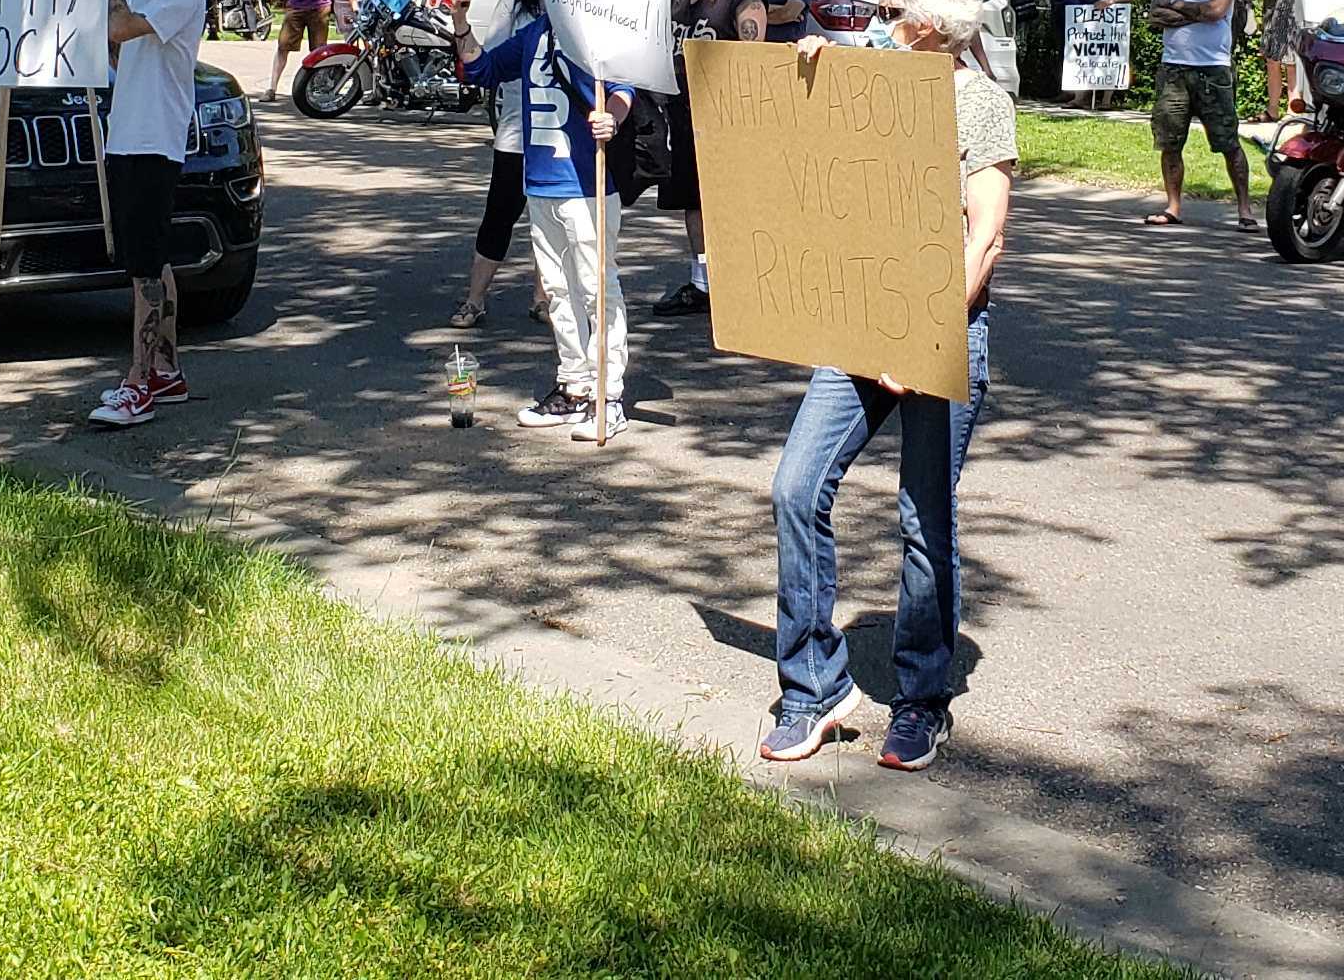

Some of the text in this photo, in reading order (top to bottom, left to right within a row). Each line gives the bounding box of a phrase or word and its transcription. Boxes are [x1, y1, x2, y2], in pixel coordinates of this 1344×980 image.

[1073, 7, 1126, 24] PLEASE
[1073, 42, 1121, 57] VICTIM
[700, 58, 943, 145] WHAT ABOUT
[782, 148, 946, 235] VICTIMS
